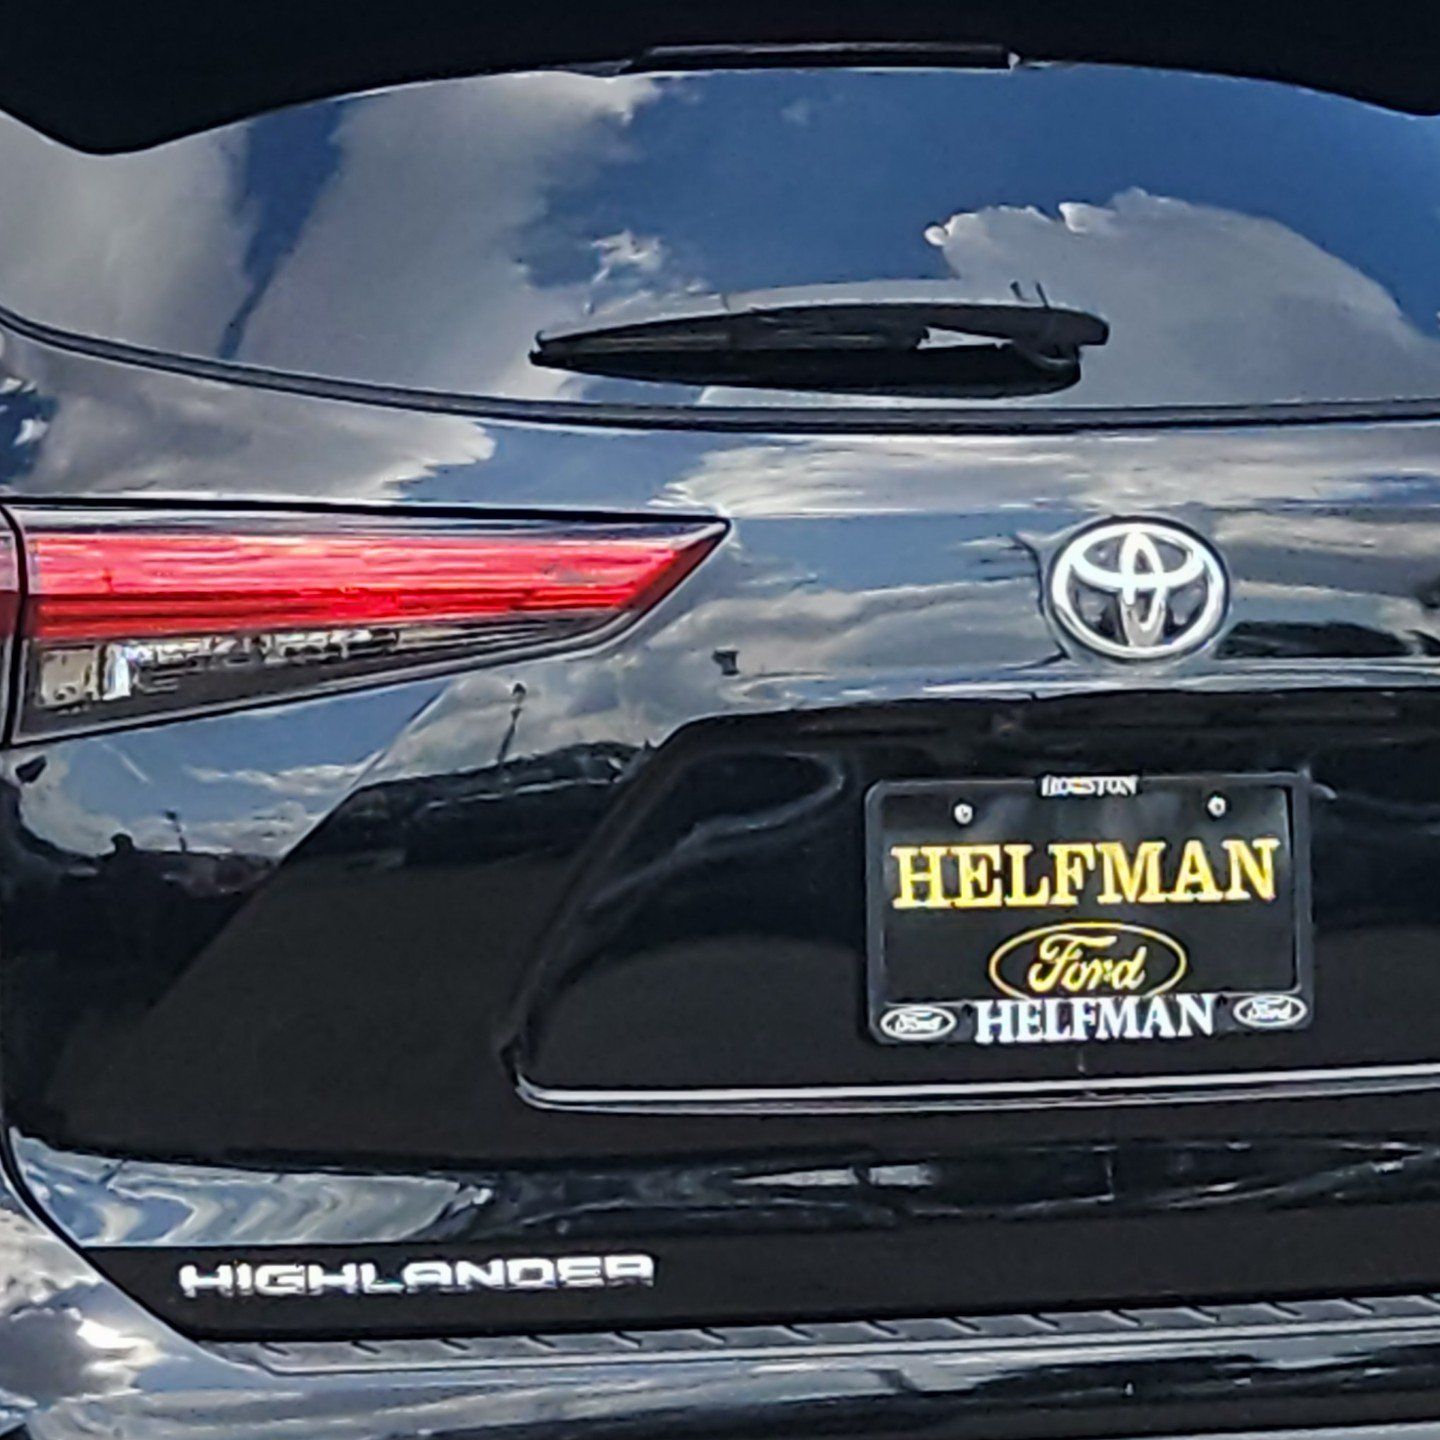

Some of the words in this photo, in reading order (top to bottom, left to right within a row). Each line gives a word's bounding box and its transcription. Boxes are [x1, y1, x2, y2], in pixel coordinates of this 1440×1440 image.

[889, 838, 1281, 909] HELFMAN
[1027, 932, 1148, 992] Ford
[974, 994, 1219, 1045] HELFMAN
[178, 1253, 655, 1298] HIGHLANDER
